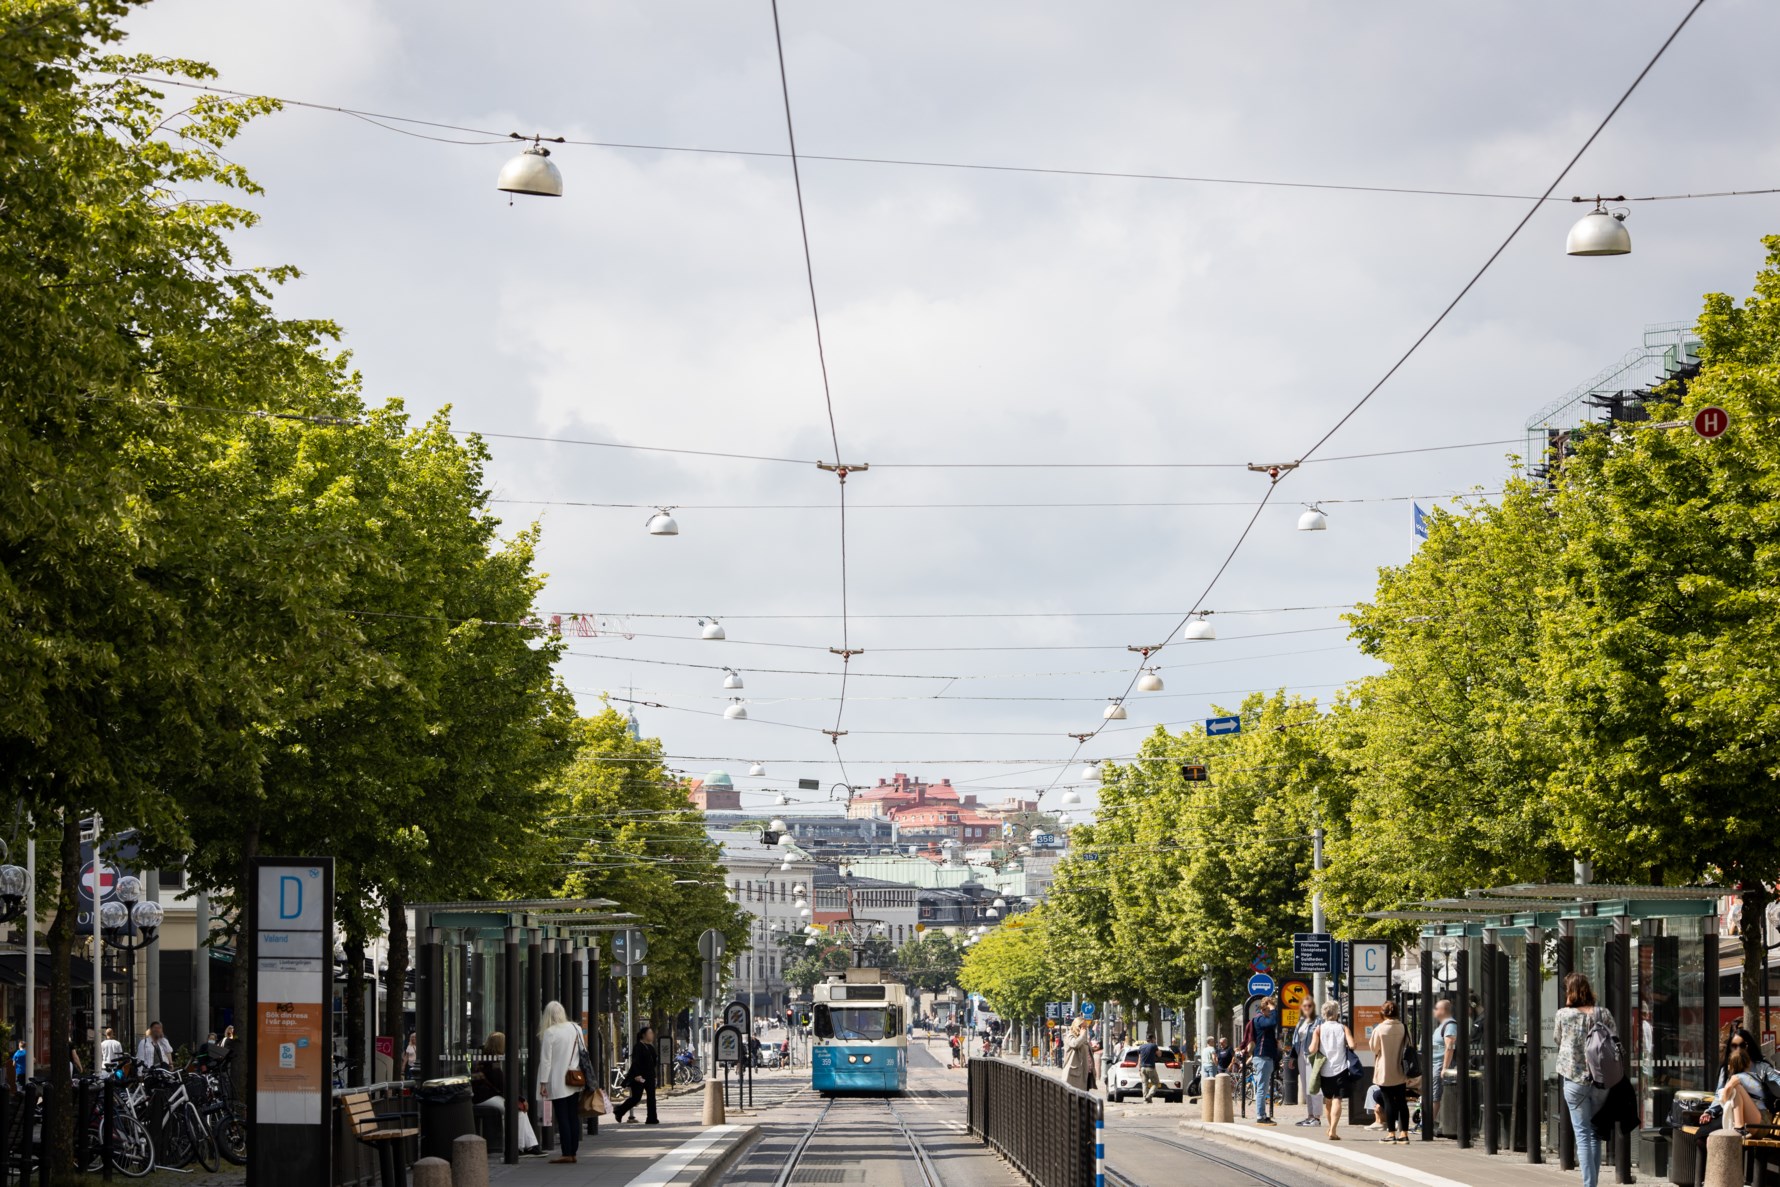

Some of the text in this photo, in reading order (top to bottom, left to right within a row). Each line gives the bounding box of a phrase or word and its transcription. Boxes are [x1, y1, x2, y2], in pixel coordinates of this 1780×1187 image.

[1704, 413, 1718, 432] H
[280, 876, 303, 919] D
[264, 934, 288, 943] Valand
[1365, 948, 1376, 971] C
